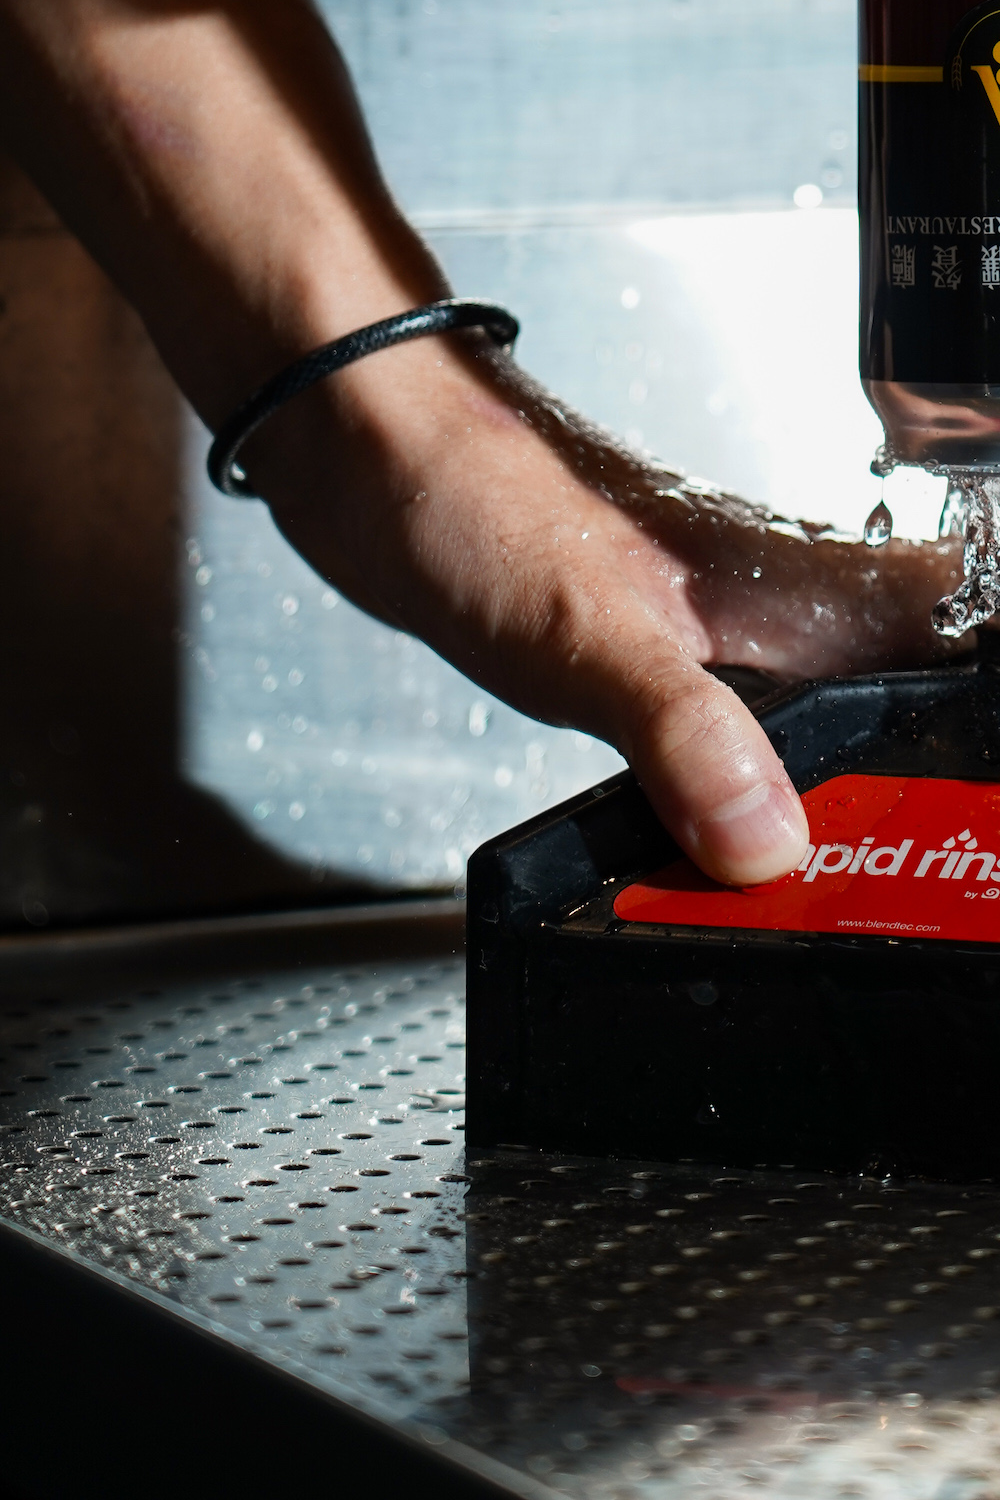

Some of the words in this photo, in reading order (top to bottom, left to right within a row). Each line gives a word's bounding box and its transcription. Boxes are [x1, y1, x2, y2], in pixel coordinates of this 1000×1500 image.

[798, 837, 914, 882] pid
[964, 890, 978, 900] by
[837, 918, 941, 933] www.blendtec.com
